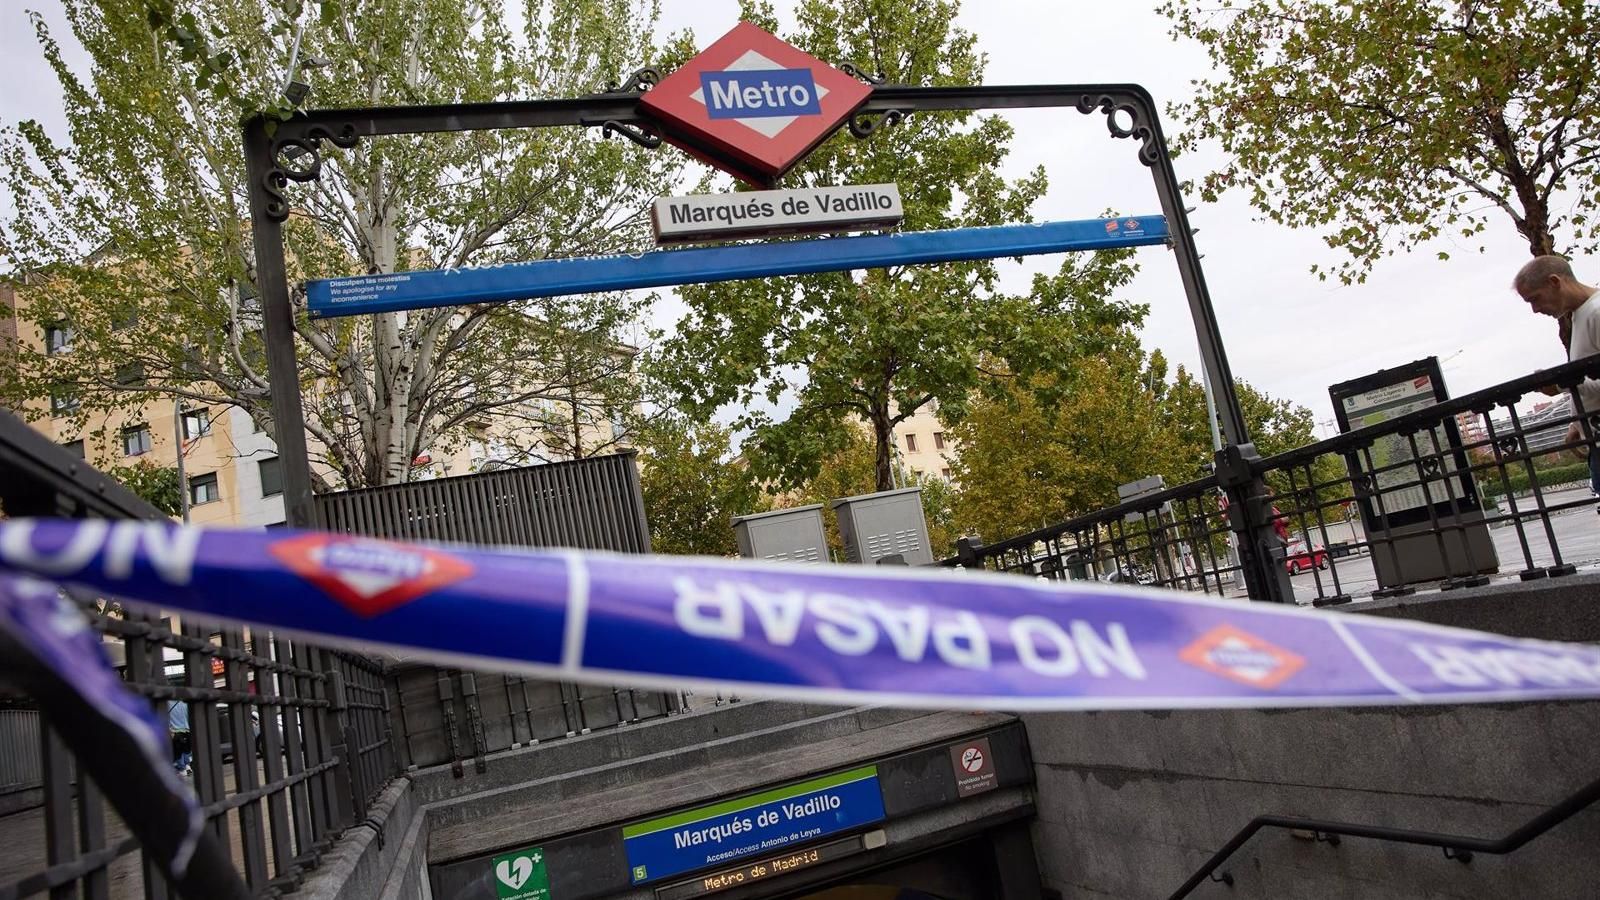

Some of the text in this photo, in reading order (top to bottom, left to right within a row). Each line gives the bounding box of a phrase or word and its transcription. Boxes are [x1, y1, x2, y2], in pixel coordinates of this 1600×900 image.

[709, 80, 810, 110] Metro
[670, 191, 892, 225] Marqués de Vadillo
[330, 279, 364, 288] Disculpen
[378, 275, 410, 283] molestias
[331, 294, 379, 303] inconvenience
[342, 286, 374, 294] apologise
[386, 284, 398, 292] any
[0, 519, 200, 586] NO
[673, 575, 1147, 681] NO PASAR
[674, 794, 840, 848] Marqués de Vadillo
[706, 827, 820, 863] Acceso/Access Antonio de Leyva
[636, 868, 644, 878] 5
[704, 850, 818, 890] Metro de Madrid
